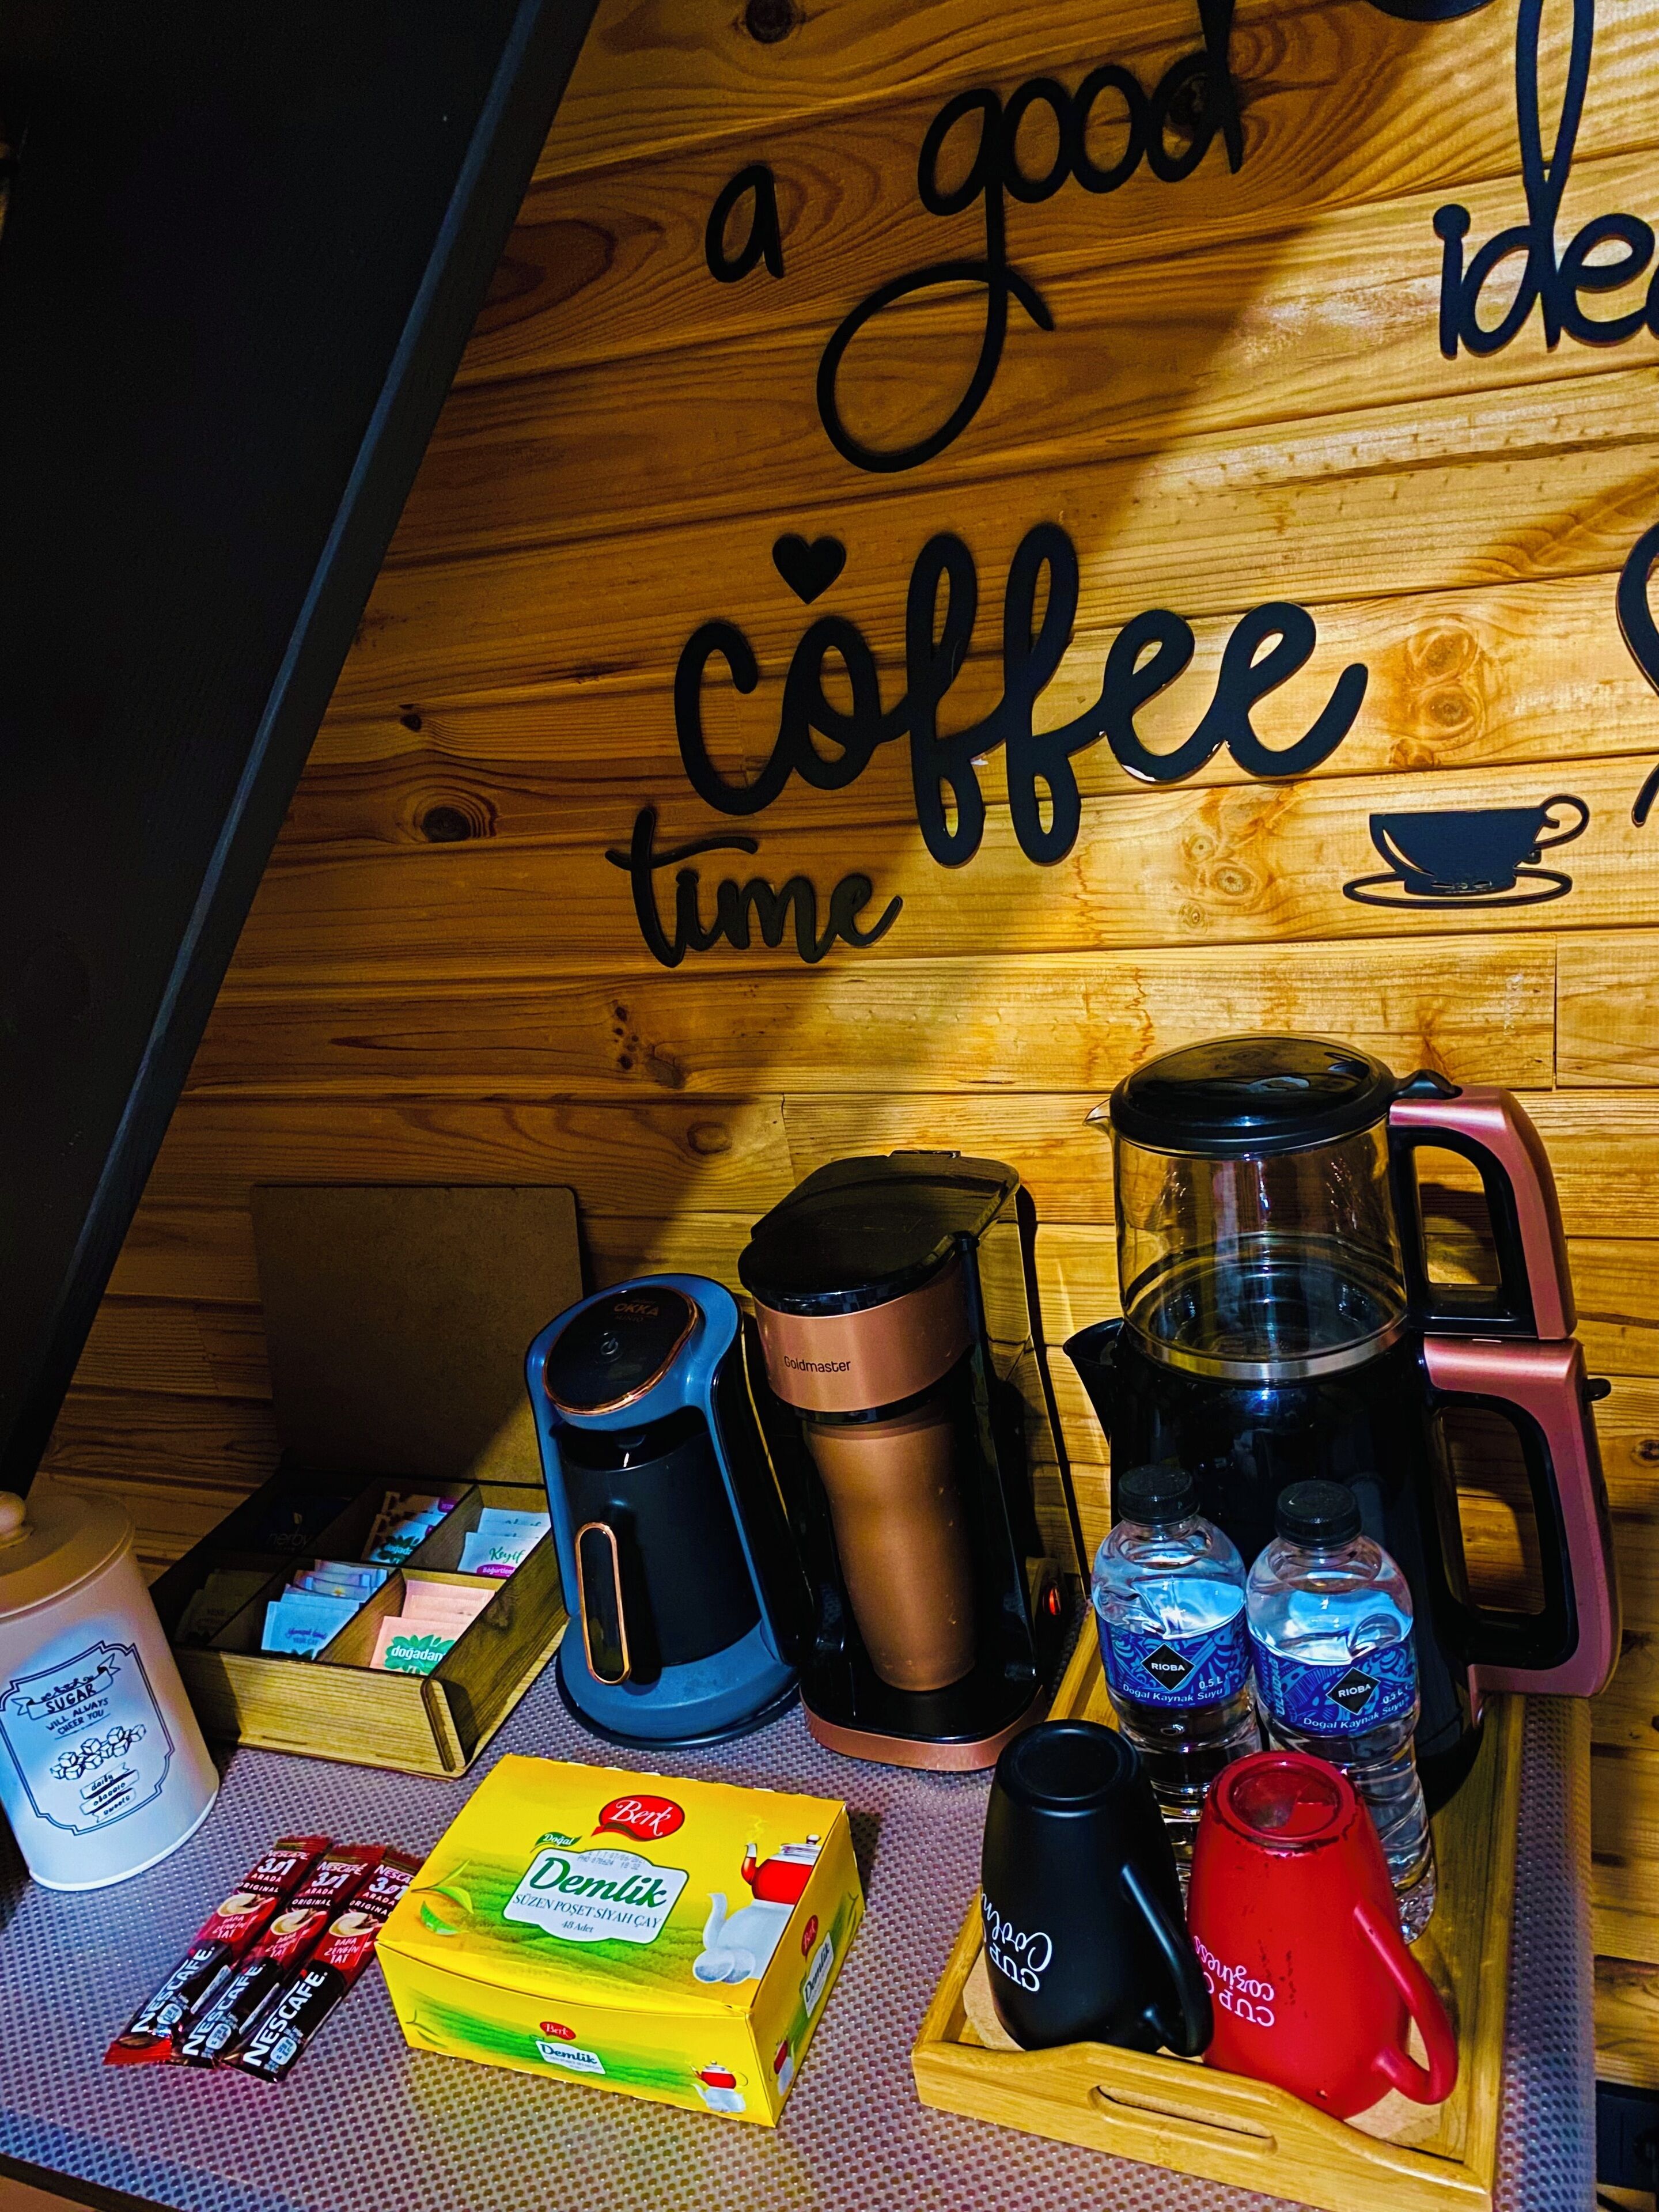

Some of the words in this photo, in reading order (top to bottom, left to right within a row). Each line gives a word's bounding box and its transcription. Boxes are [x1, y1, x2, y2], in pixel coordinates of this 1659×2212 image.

[1433, 0, 1659, 360] ide
[706, 160, 784, 283] a
[817, 0, 1243, 473] good
[674, 522, 1369, 868] coffee
[605, 807, 903, 968] time
[614, 1302, 659, 1316] OKKA
[784, 1355, 851, 1372] Goldmaster
[1151, 1662, 1185, 1672] RIOBA
[1199, 1679, 1214, 1690] 0.5
[1217, 1676, 1223, 1684] L
[1338, 1683, 1372, 1698] RIOBA
[46, 1683, 97, 1714] SUGAR
[1153, 1692, 1194, 1703] Kaynak
[1197, 1688, 1224, 1700] Suyu
[1382, 1692, 1396, 1704] 0.5
[46, 1715, 70, 1731] WILL
[73, 1698, 109, 1718] ALWAYS
[58, 1717, 85, 1734] CHEER
[87, 1709, 104, 1721] YOU
[1340, 1711, 1379, 1729] Kaynak
[1382, 1699, 1406, 1715] Suyu
[608, 1800, 674, 1837] Berk
[543, 1834, 574, 1846] Doğal
[251, 1873, 282, 1883] ARADA
[374, 1864, 415, 1885] NESCA
[529, 1857, 667, 1908] Demlik
[237, 1881, 279, 1893] ORIGINAL
[291, 1899, 332, 1907] ORIGINAL
[362, 1892, 396, 1906] ARADA
[513, 1893, 555, 1910] SÜZEN
[557, 1902, 597, 1916] POŞET
[593, 1907, 634, 1925] SİYAH
[634, 1915, 662, 1930] ÇAY
[562, 1920, 575, 1929] 48
[576, 1922, 594, 1933] Adet
[805, 1942, 830, 2003] Demlik
[989, 1942, 1040, 1992] CUP
[1218, 1988, 1275, 2027] CUP
[545, 2023, 572, 2039] Berk
[540, 2044, 598, 2065] Demlik
